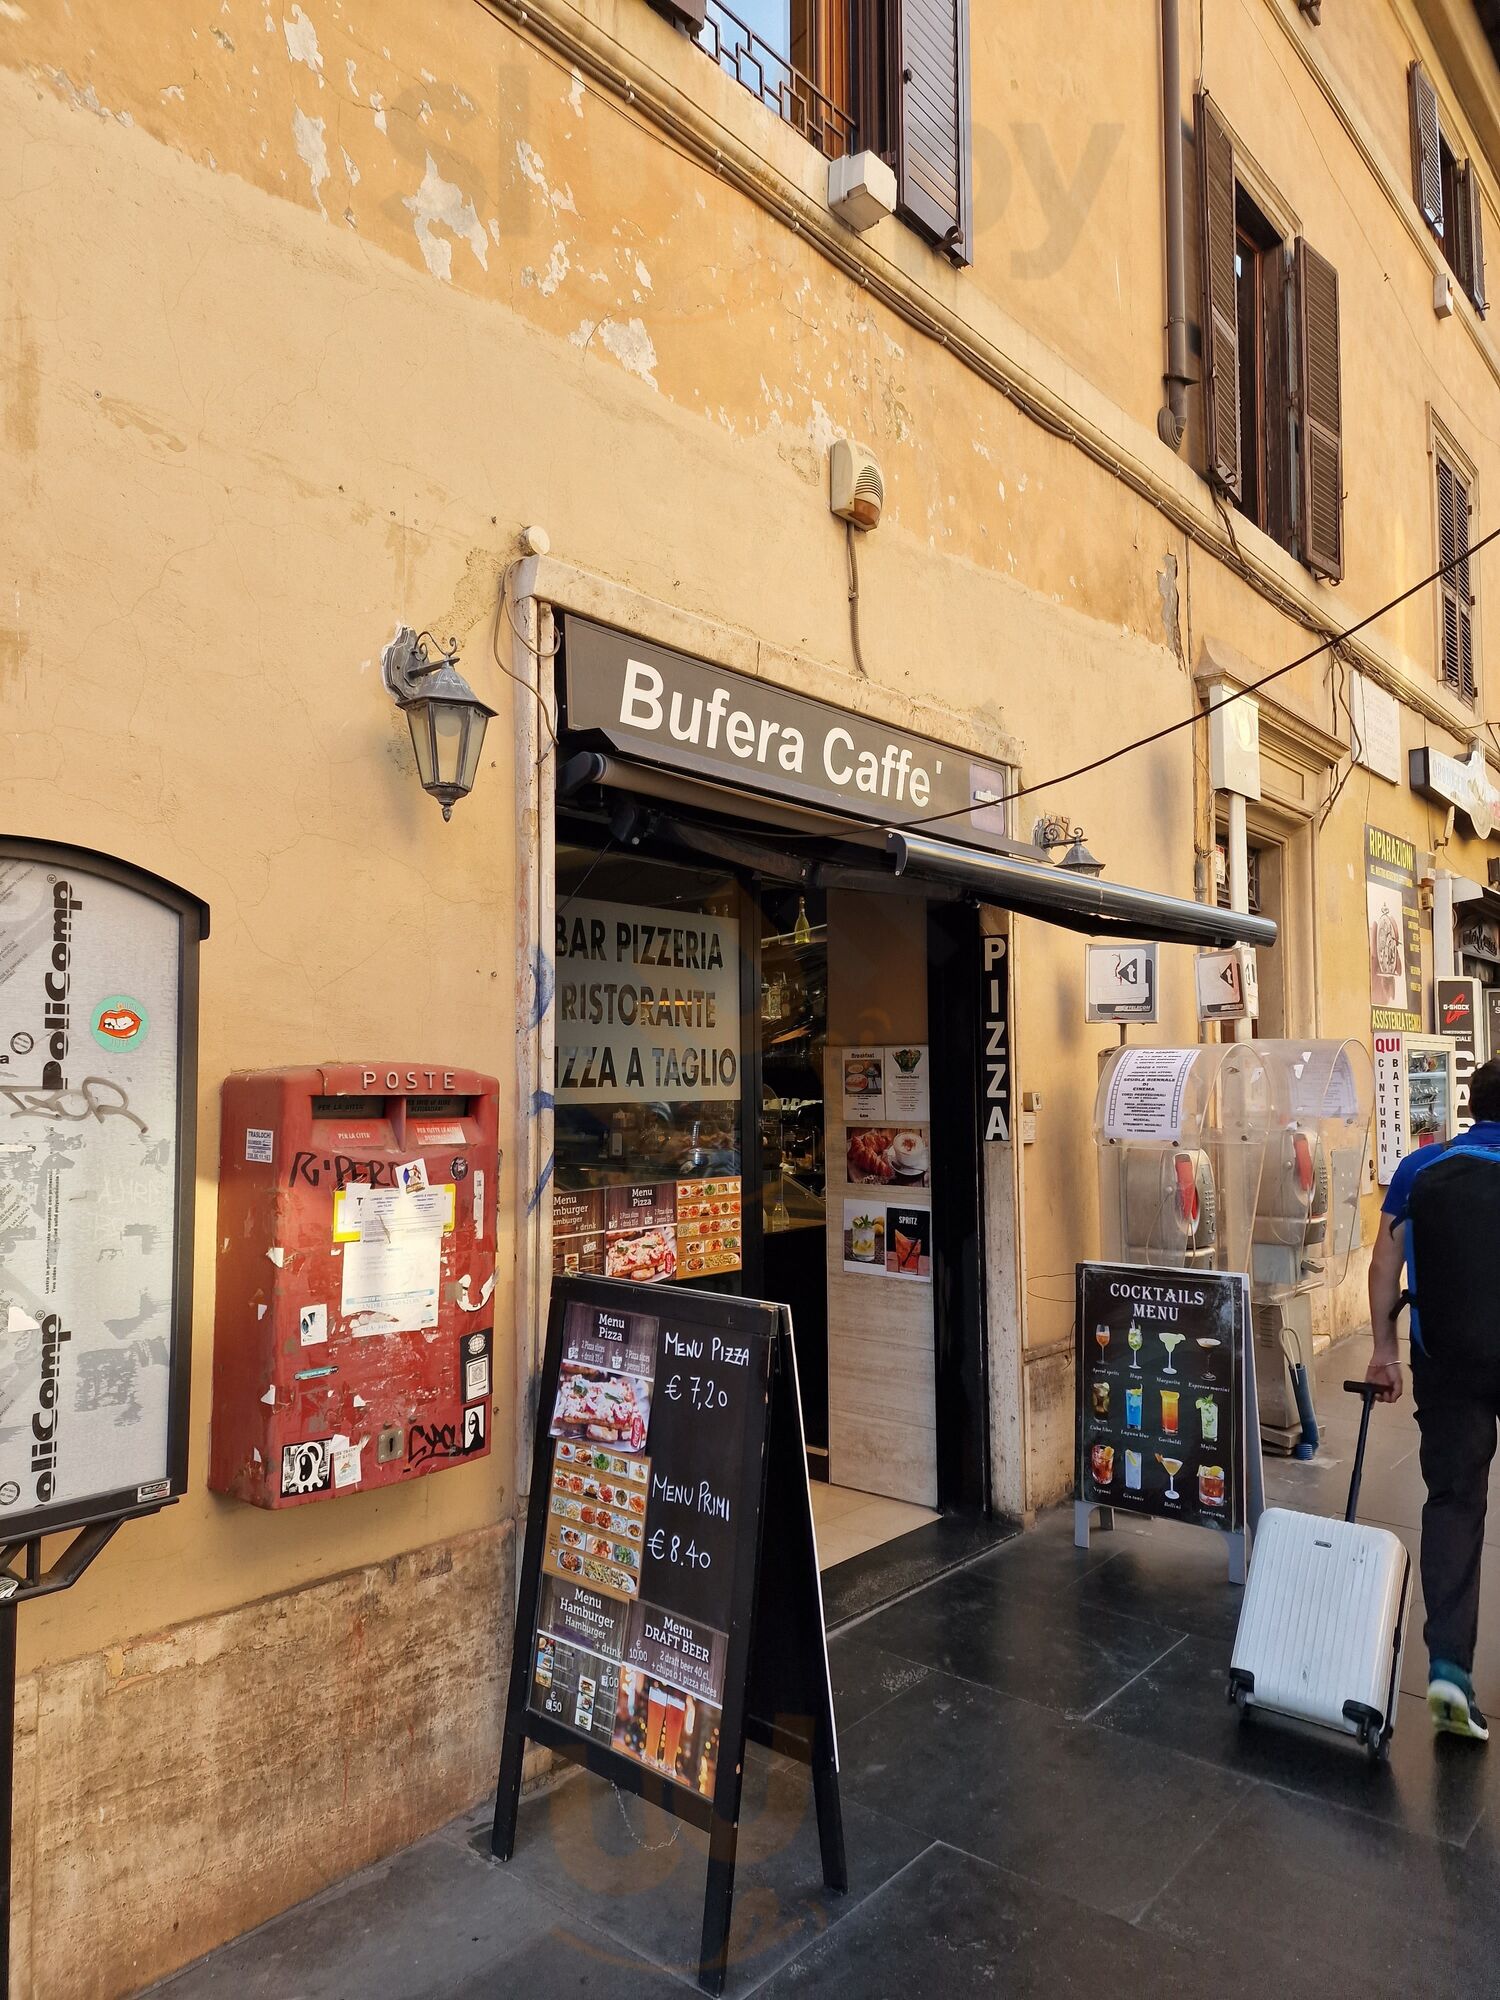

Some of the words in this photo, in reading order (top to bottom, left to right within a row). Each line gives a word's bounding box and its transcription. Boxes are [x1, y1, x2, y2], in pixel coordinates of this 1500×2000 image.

[619, 658, 805, 774] Bufera
[823, 727, 943, 808] Caffe'
[1369, 828, 1413, 872] RIPARAZIONI
[556, 913, 607, 961] BAR
[616, 922, 723, 970] PIZZERIA
[561, 983, 716, 1028] RISTORANTE
[984, 937, 1010, 1140] PIZZA
[1375, 1038, 1400, 1053] QUI
[554, 1046, 617, 1088] IZZA
[625, 1047, 645, 1088] A
[651, 1047, 737, 1088] TAGLIO
[362, 1071, 456, 1090] POSTE
[1378, 1059, 1388, 1165] CINTURINI
[1392, 1058, 1402, 1159] BATTERIE
[553, 1196, 577, 1205] Menu
[631, 1187, 653, 1197] Menu
[632, 1198, 652, 1206] Pizza
[553, 1205, 589, 1216] mburger
[898, 1216, 918, 1225] SPRITZ
[580, 1223, 596, 1231] drink
[1109, 1282, 1205, 1306] COCKTAILS
[598, 1313, 625, 1329] Menu
[1133, 1303, 1180, 1321] MENU
[598, 1327, 623, 1341] Pizza
[711, 1337, 750, 1367] PIZZA
[665, 1374, 682, 1401] €
[690, 1376, 728, 1411] 7,20
[1156, 1377, 1181, 1386] Margarita
[31, 1313, 72, 1508] oliComp
[1158, 1436, 1182, 1446] Garibaldi
[1200, 1443, 1218, 1451] Mojito
[697, 1480, 730, 1522] PRIMI
[1164, 1501, 1182, 1510] Bellini
[574, 1588, 602, 1609] Menu
[559, 1597, 615, 1629] Hamburger
[564, 1615, 607, 1640] Hamburger
[663, 1616, 693, 1640] Menu
[601, 1643, 622, 1659] drink
[629, 1648, 648, 1662] 10,00
[644, 1624, 681, 1649] DRAFT
[681, 1638, 710, 1663] BEER
[664, 1653, 680, 1667] draft
[680, 1659, 694, 1673] beer
[694, 1665, 703, 1677] 40
[656, 1663, 673, 1678] chips
[683, 1675, 699, 1689] pizza
[699, 1680, 717, 1698] slices
